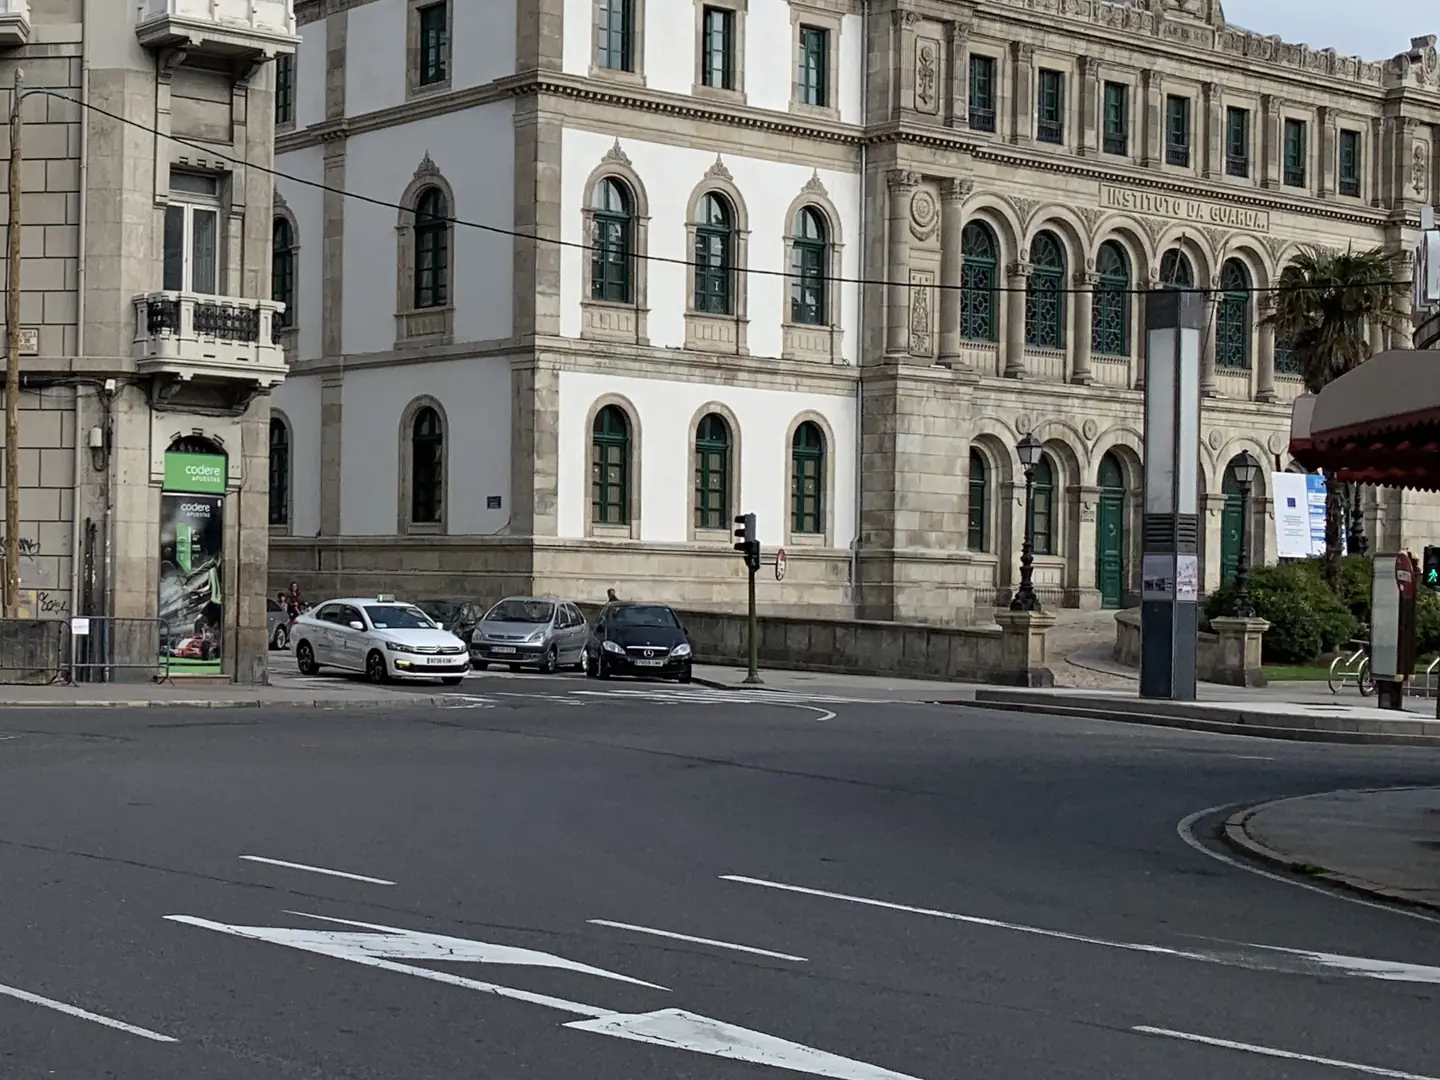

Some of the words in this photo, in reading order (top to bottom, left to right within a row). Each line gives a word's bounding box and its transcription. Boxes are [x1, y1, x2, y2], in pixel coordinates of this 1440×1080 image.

[1108, 187, 1181, 216] INSTITUTO
[1186, 201, 1204, 220] DA
[185, 465, 221, 476] codere
[181, 503, 210, 512] codere
